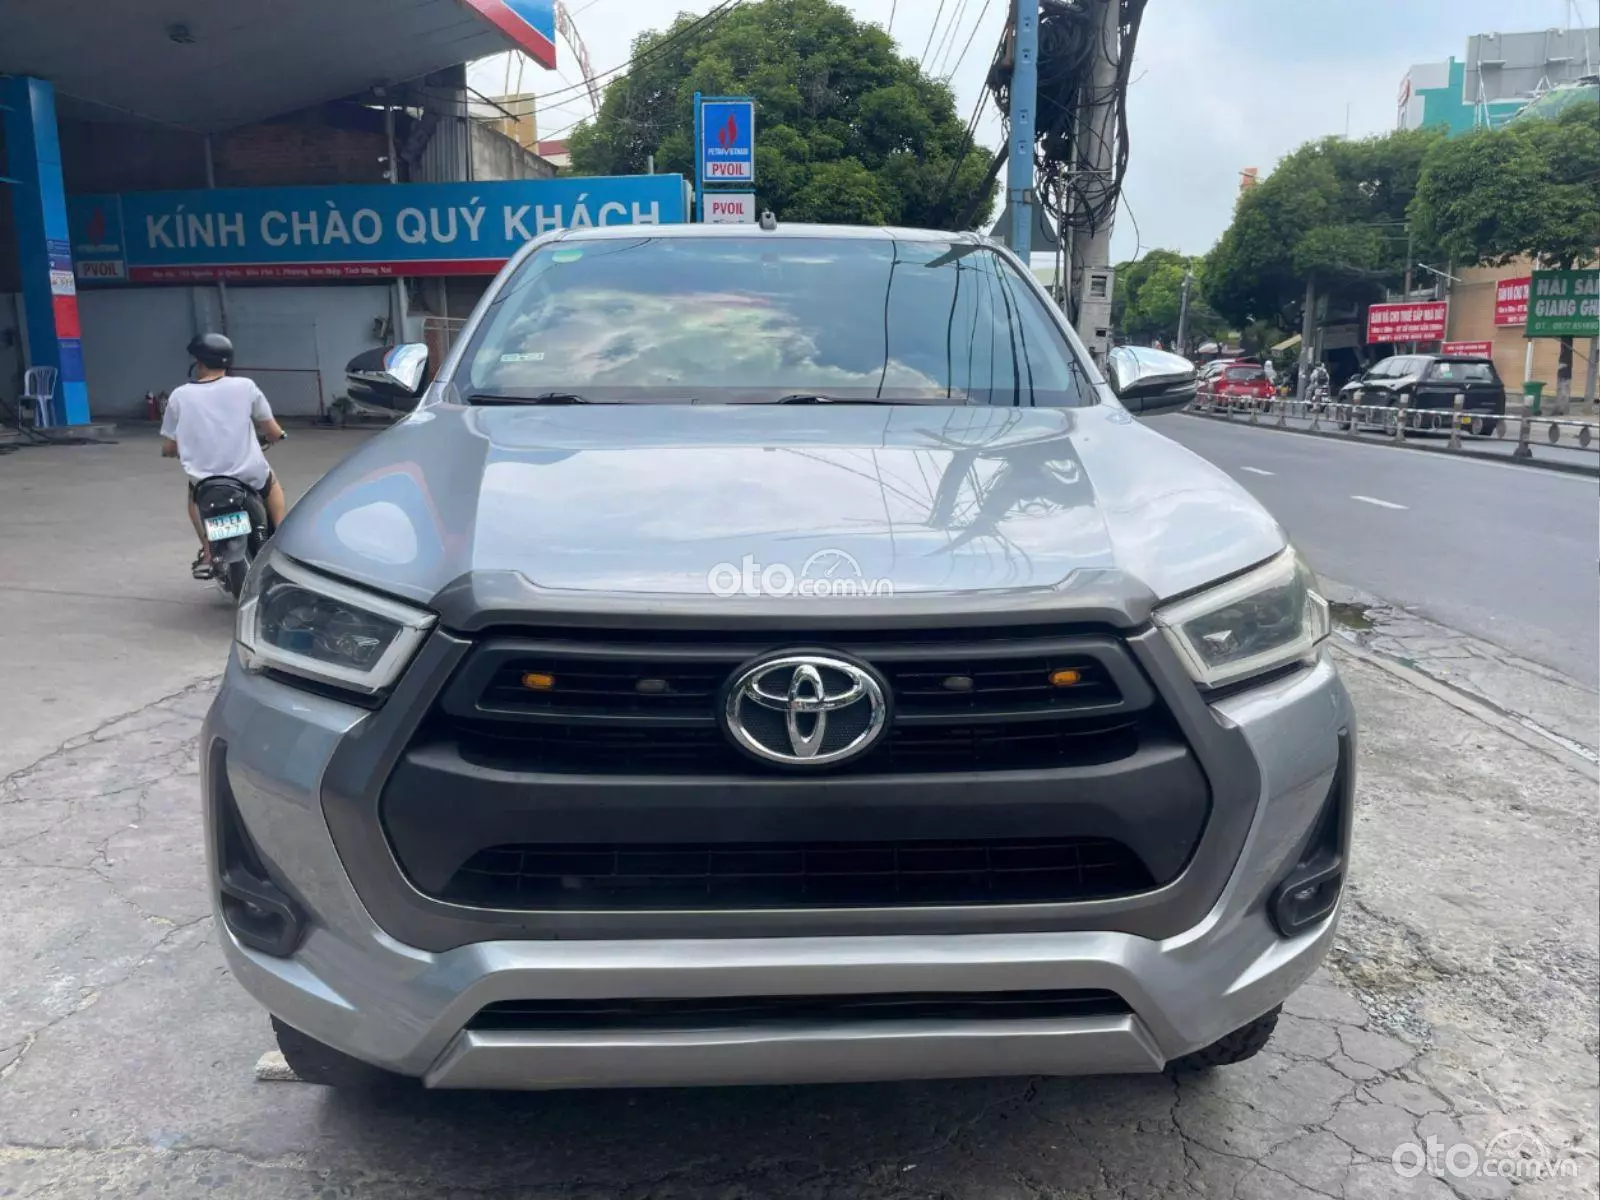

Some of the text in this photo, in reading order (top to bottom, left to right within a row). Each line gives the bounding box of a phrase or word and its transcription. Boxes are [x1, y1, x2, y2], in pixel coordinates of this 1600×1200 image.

[712, 163, 744, 176] PVOIL
[712, 202, 745, 215] PVOIL
[146, 193, 660, 249] KÍNH CHÀO QUÝ KHÁCH
[83, 263, 118, 277] PVOIL
[1535, 299, 1576, 317] GIANG
